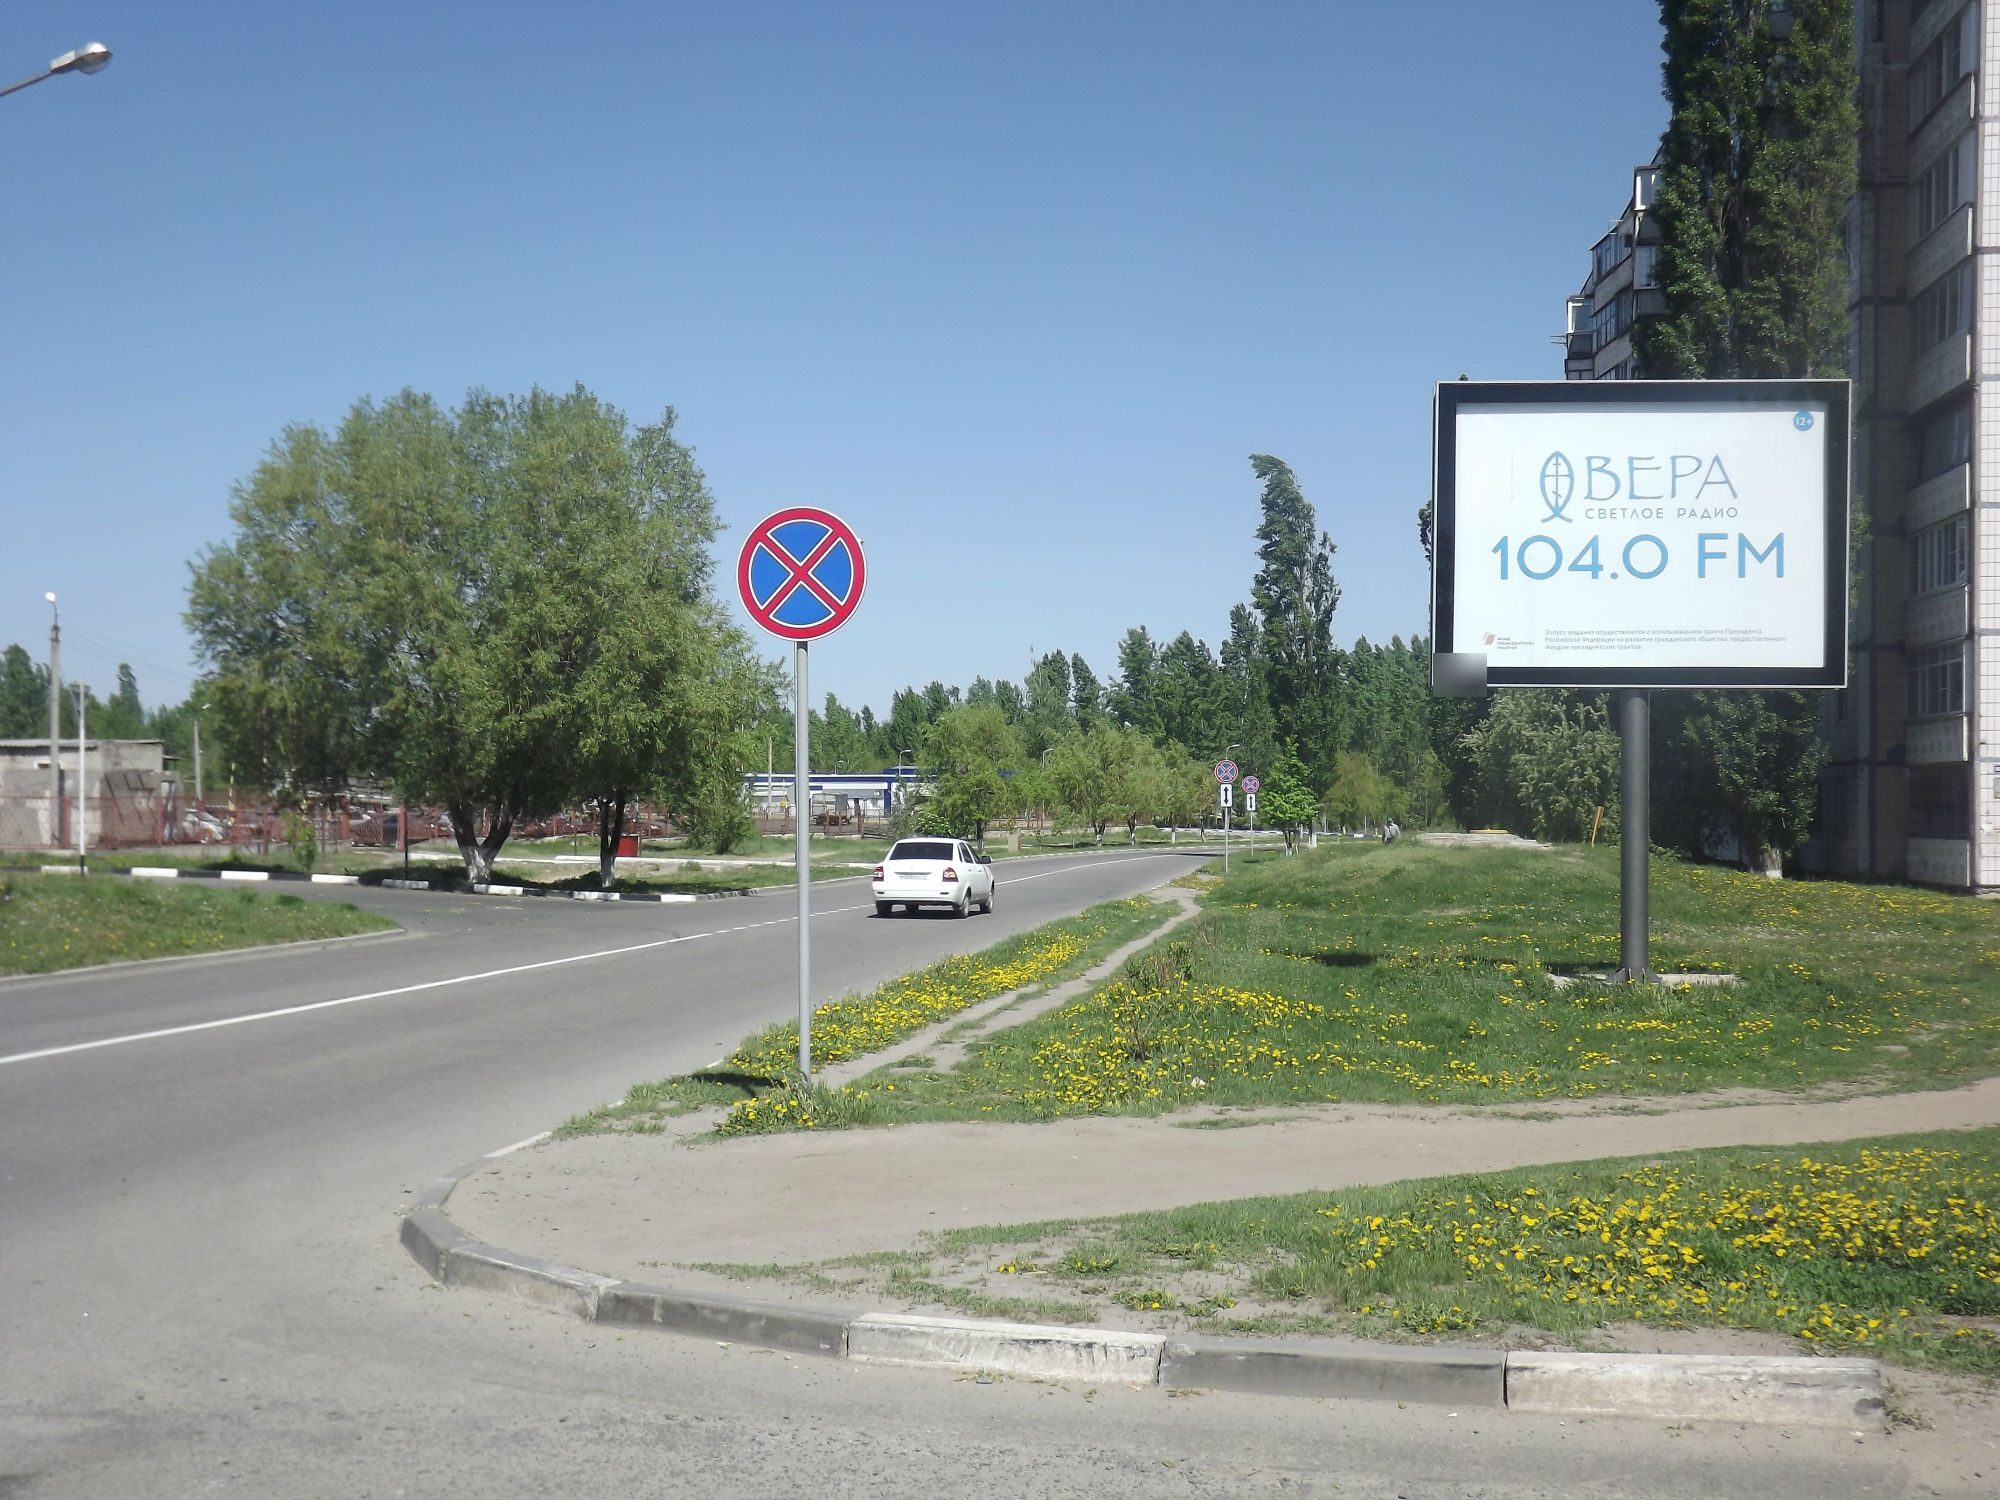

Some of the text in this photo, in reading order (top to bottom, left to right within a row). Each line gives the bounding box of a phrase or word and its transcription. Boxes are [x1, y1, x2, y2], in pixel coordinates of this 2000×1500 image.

[1795, 415, 1813, 426] 12+
[1584, 454, 1738, 501] ВЕРА
[1585, 506, 1738, 519] СВЕТЛОЕ РАДИО
[1491, 532, 1785, 580] 104.0 FM
